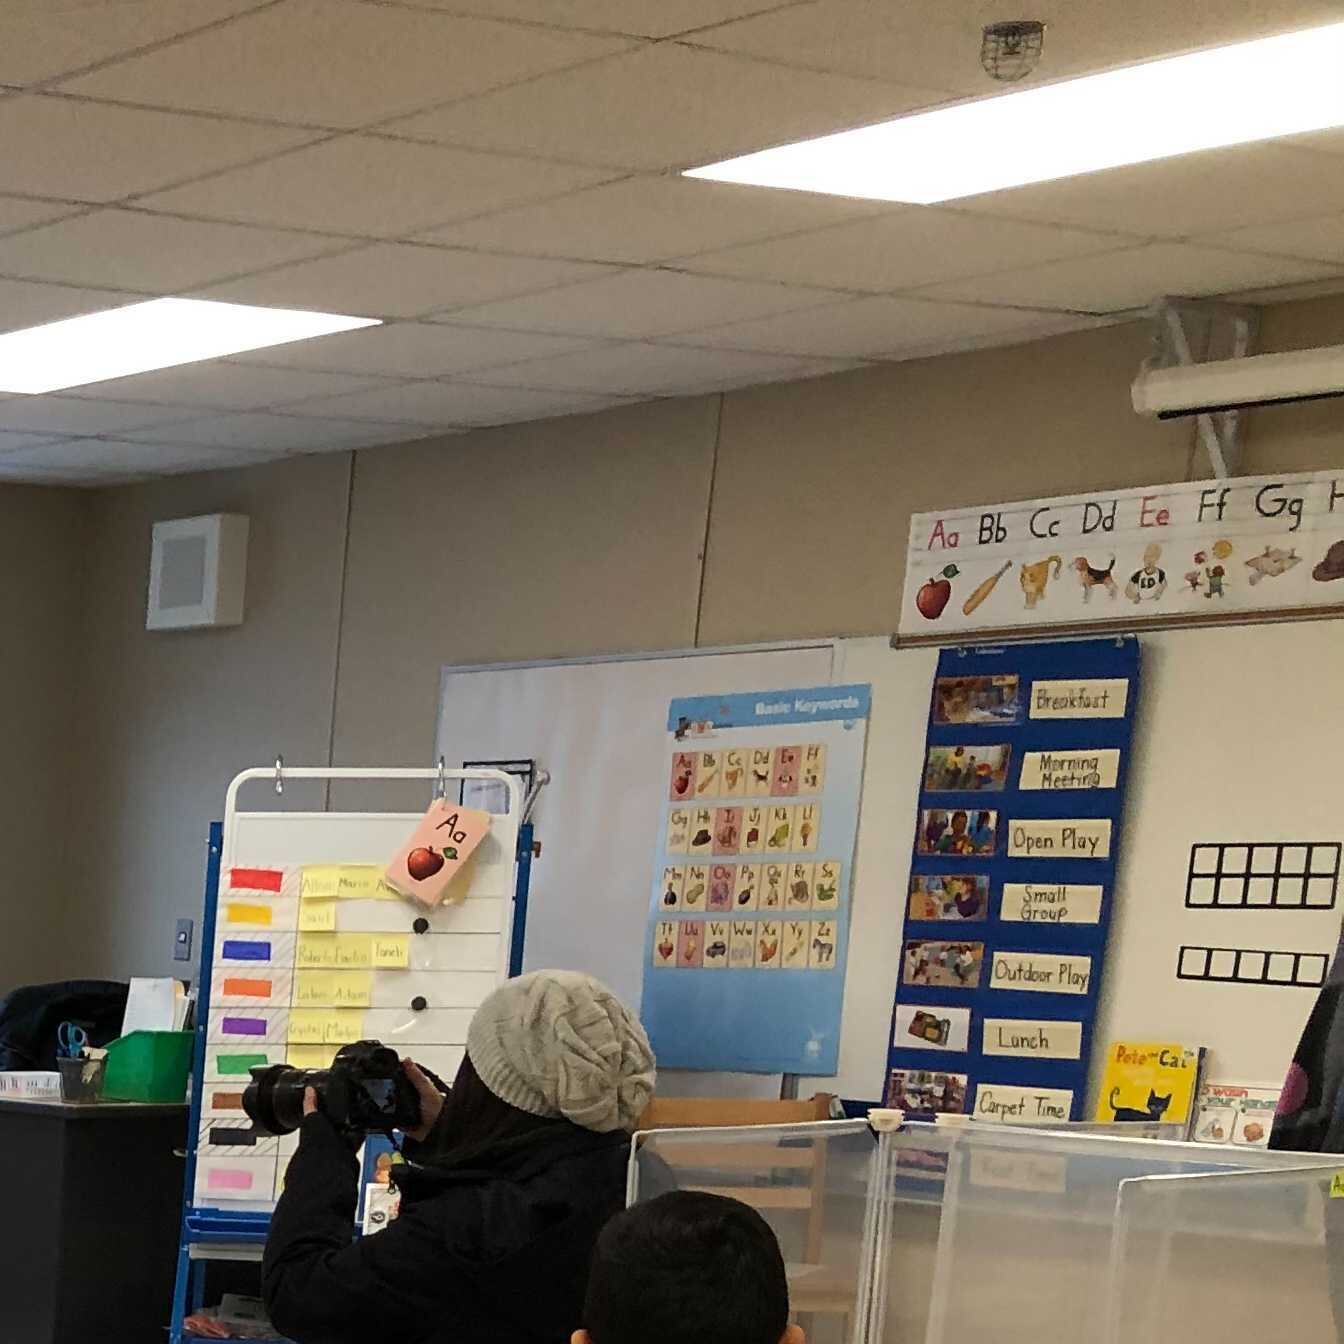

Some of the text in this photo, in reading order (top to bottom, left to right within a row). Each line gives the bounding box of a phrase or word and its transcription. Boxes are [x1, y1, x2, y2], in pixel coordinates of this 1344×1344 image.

[927, 519, 960, 551] Aa
[978, 512, 1008, 545] Bb
[1029, 507, 1060, 539] Cc
[1082, 500, 1117, 535] Dd
[1139, 495, 1170, 528] Ee
[1197, 487, 1231, 522] Ff
[1255, 484, 1304, 532] Gg
[755, 696, 860, 716] Basic Keywords
[1036, 687, 1110, 710] Breakfast
[703, 753, 716, 767] Bb
[727, 752, 741, 766] Cc
[753, 751, 769, 765] Dd
[780, 748, 794, 764] Ee
[1039, 754, 1099, 774] Morning
[1041, 771, 1101, 789] Meeting
[435, 813, 467, 844] Aa
[1013, 827, 1100, 857] Open Play
[740, 866, 755, 882] Pp
[822, 864, 834, 879] Ss
[1023, 885, 1067, 903] Small
[1020, 903, 1069, 922] Group
[733, 921, 753, 936] Ww
[994, 959, 1089, 992] Outdoor Play
[998, 1026, 1049, 1049] Lunch
[1114, 1045, 1147, 1066] Pete
[979, 1089, 1067, 1121] Carpet Time
